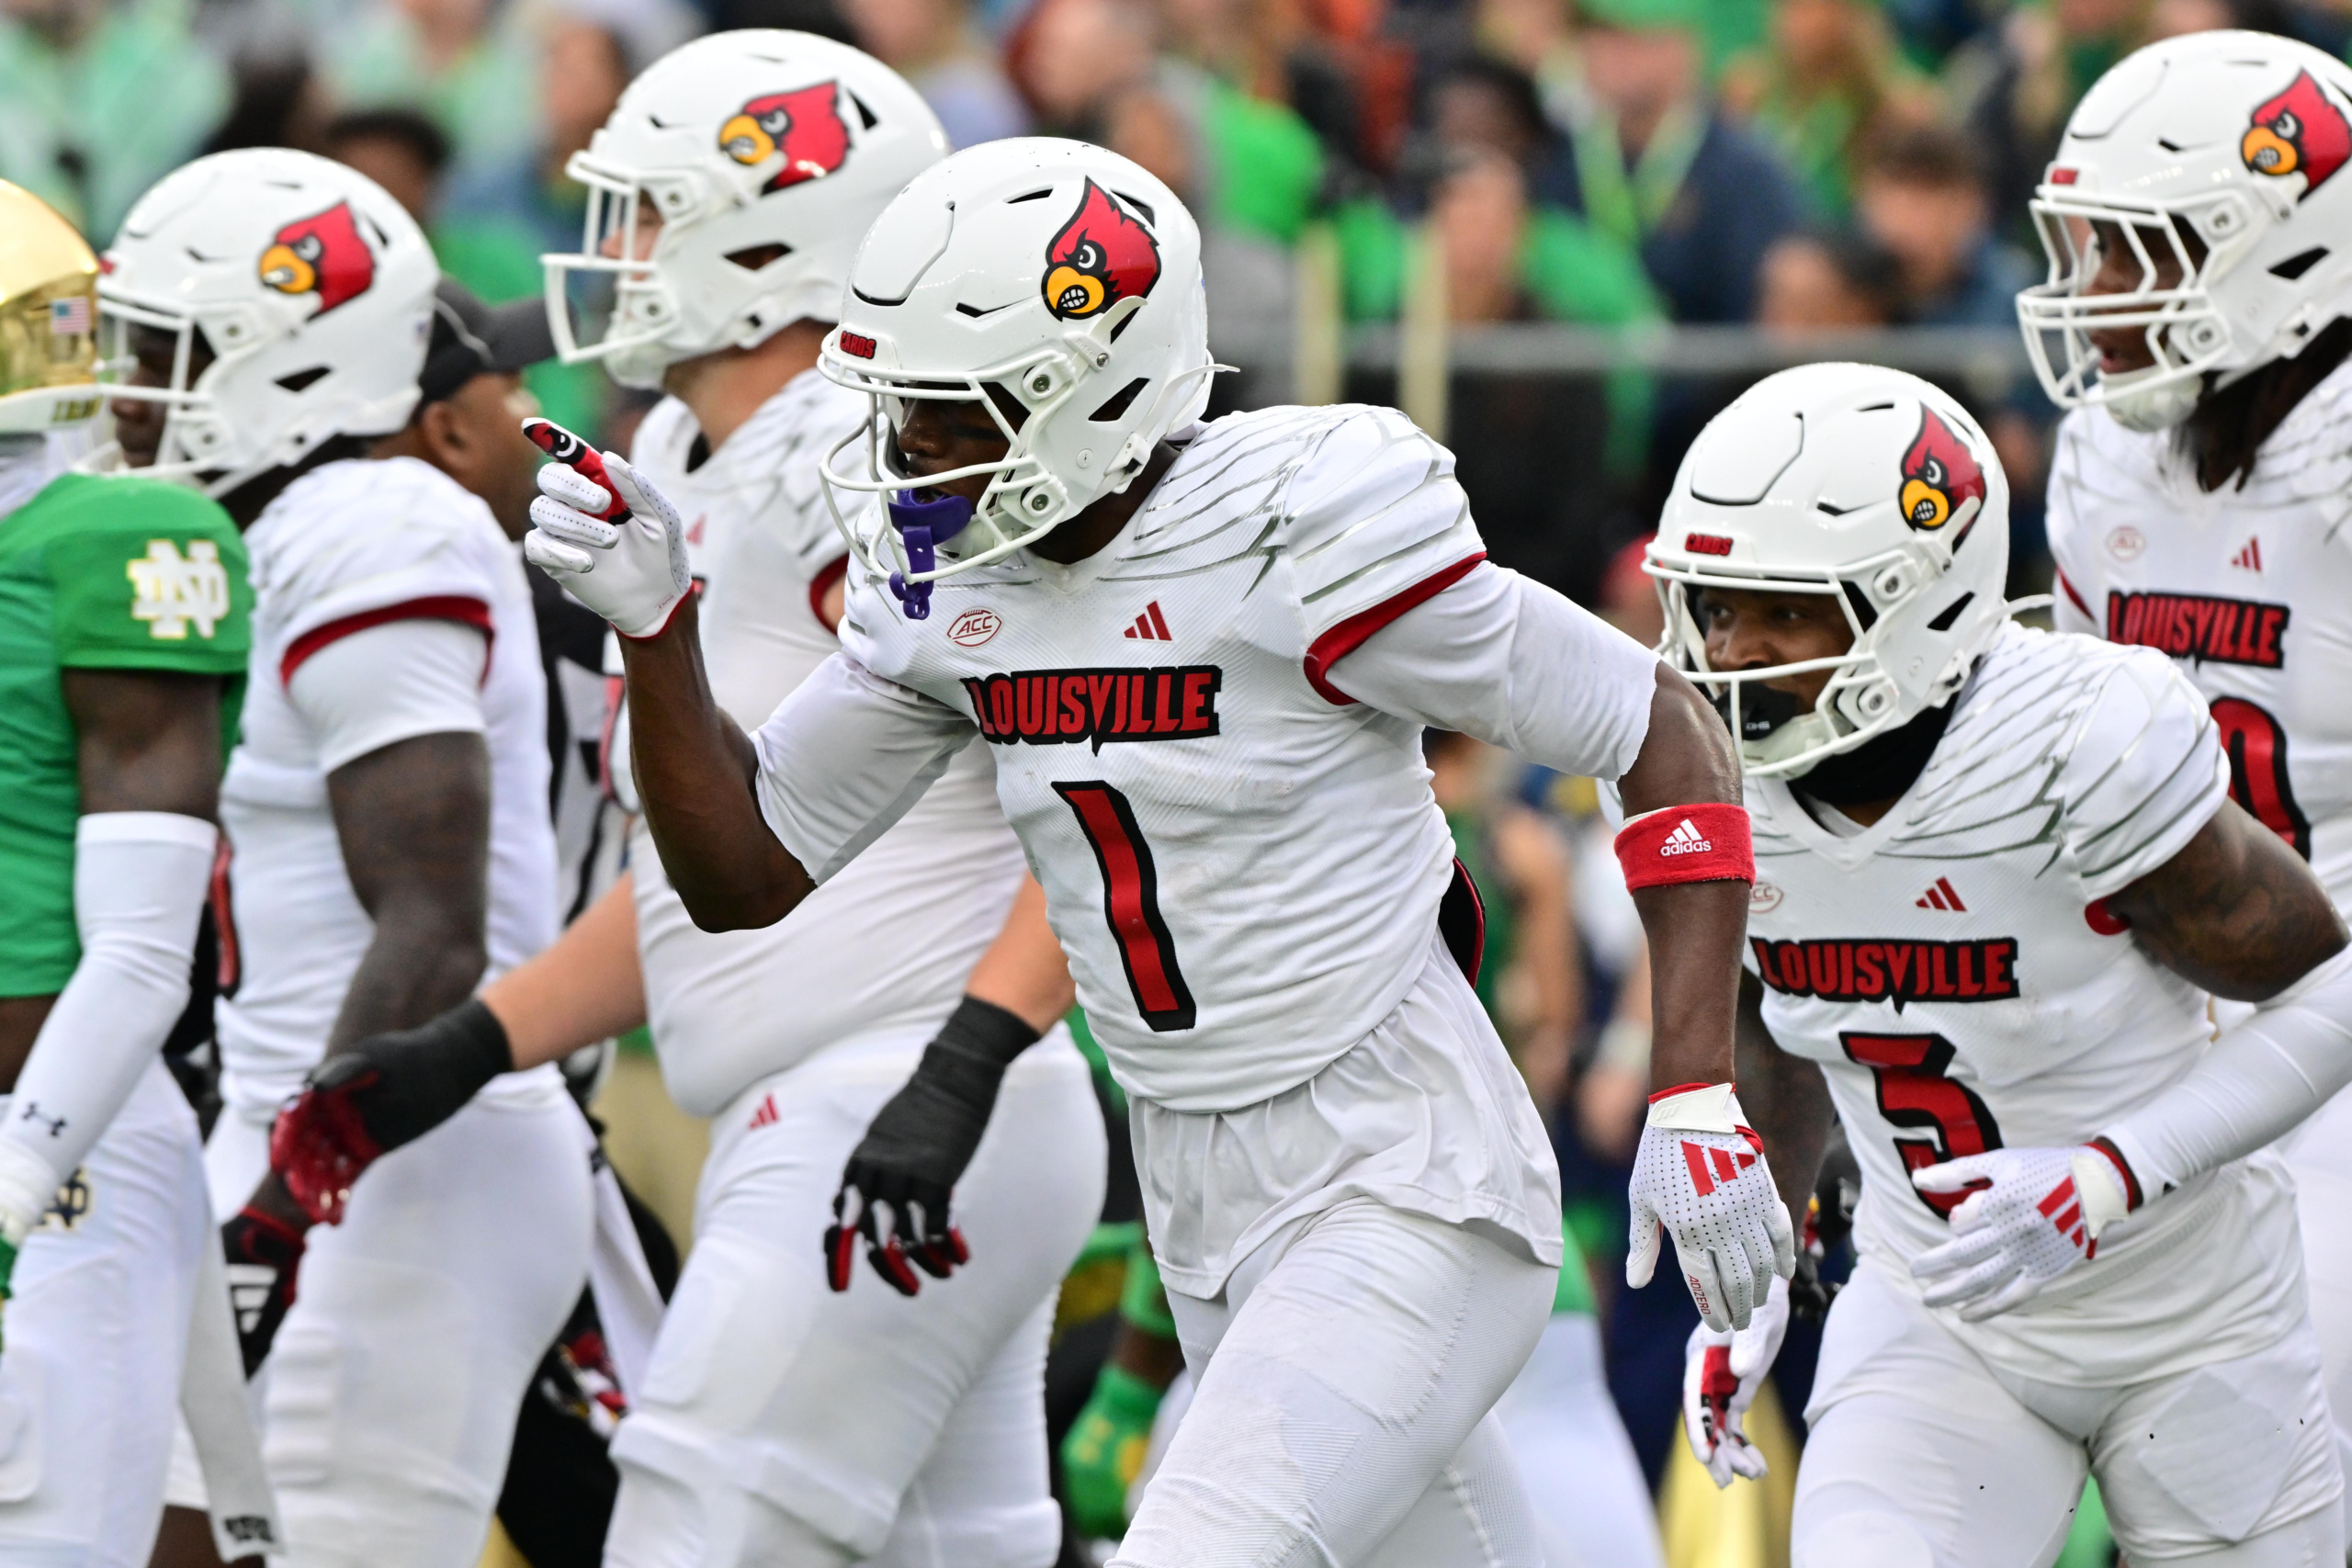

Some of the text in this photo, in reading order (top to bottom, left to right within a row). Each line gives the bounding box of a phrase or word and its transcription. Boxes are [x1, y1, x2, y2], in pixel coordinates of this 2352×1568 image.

[840, 331, 876, 359] CARDS
[1685, 533, 1734, 557] CARDS
[956, 615, 993, 636] ACC
[2108, 591, 2290, 670] LOUISVILLE
[961, 665, 1222, 750] LOUISVILLE
[1660, 840, 1712, 857] adidas
[1051, 780, 1196, 1032] 1
[1748, 937, 2020, 1009] LOUISVILLE
[1838, 1032, 2006, 1223] 3
[1687, 1273, 1712, 1314] ADIZERO
